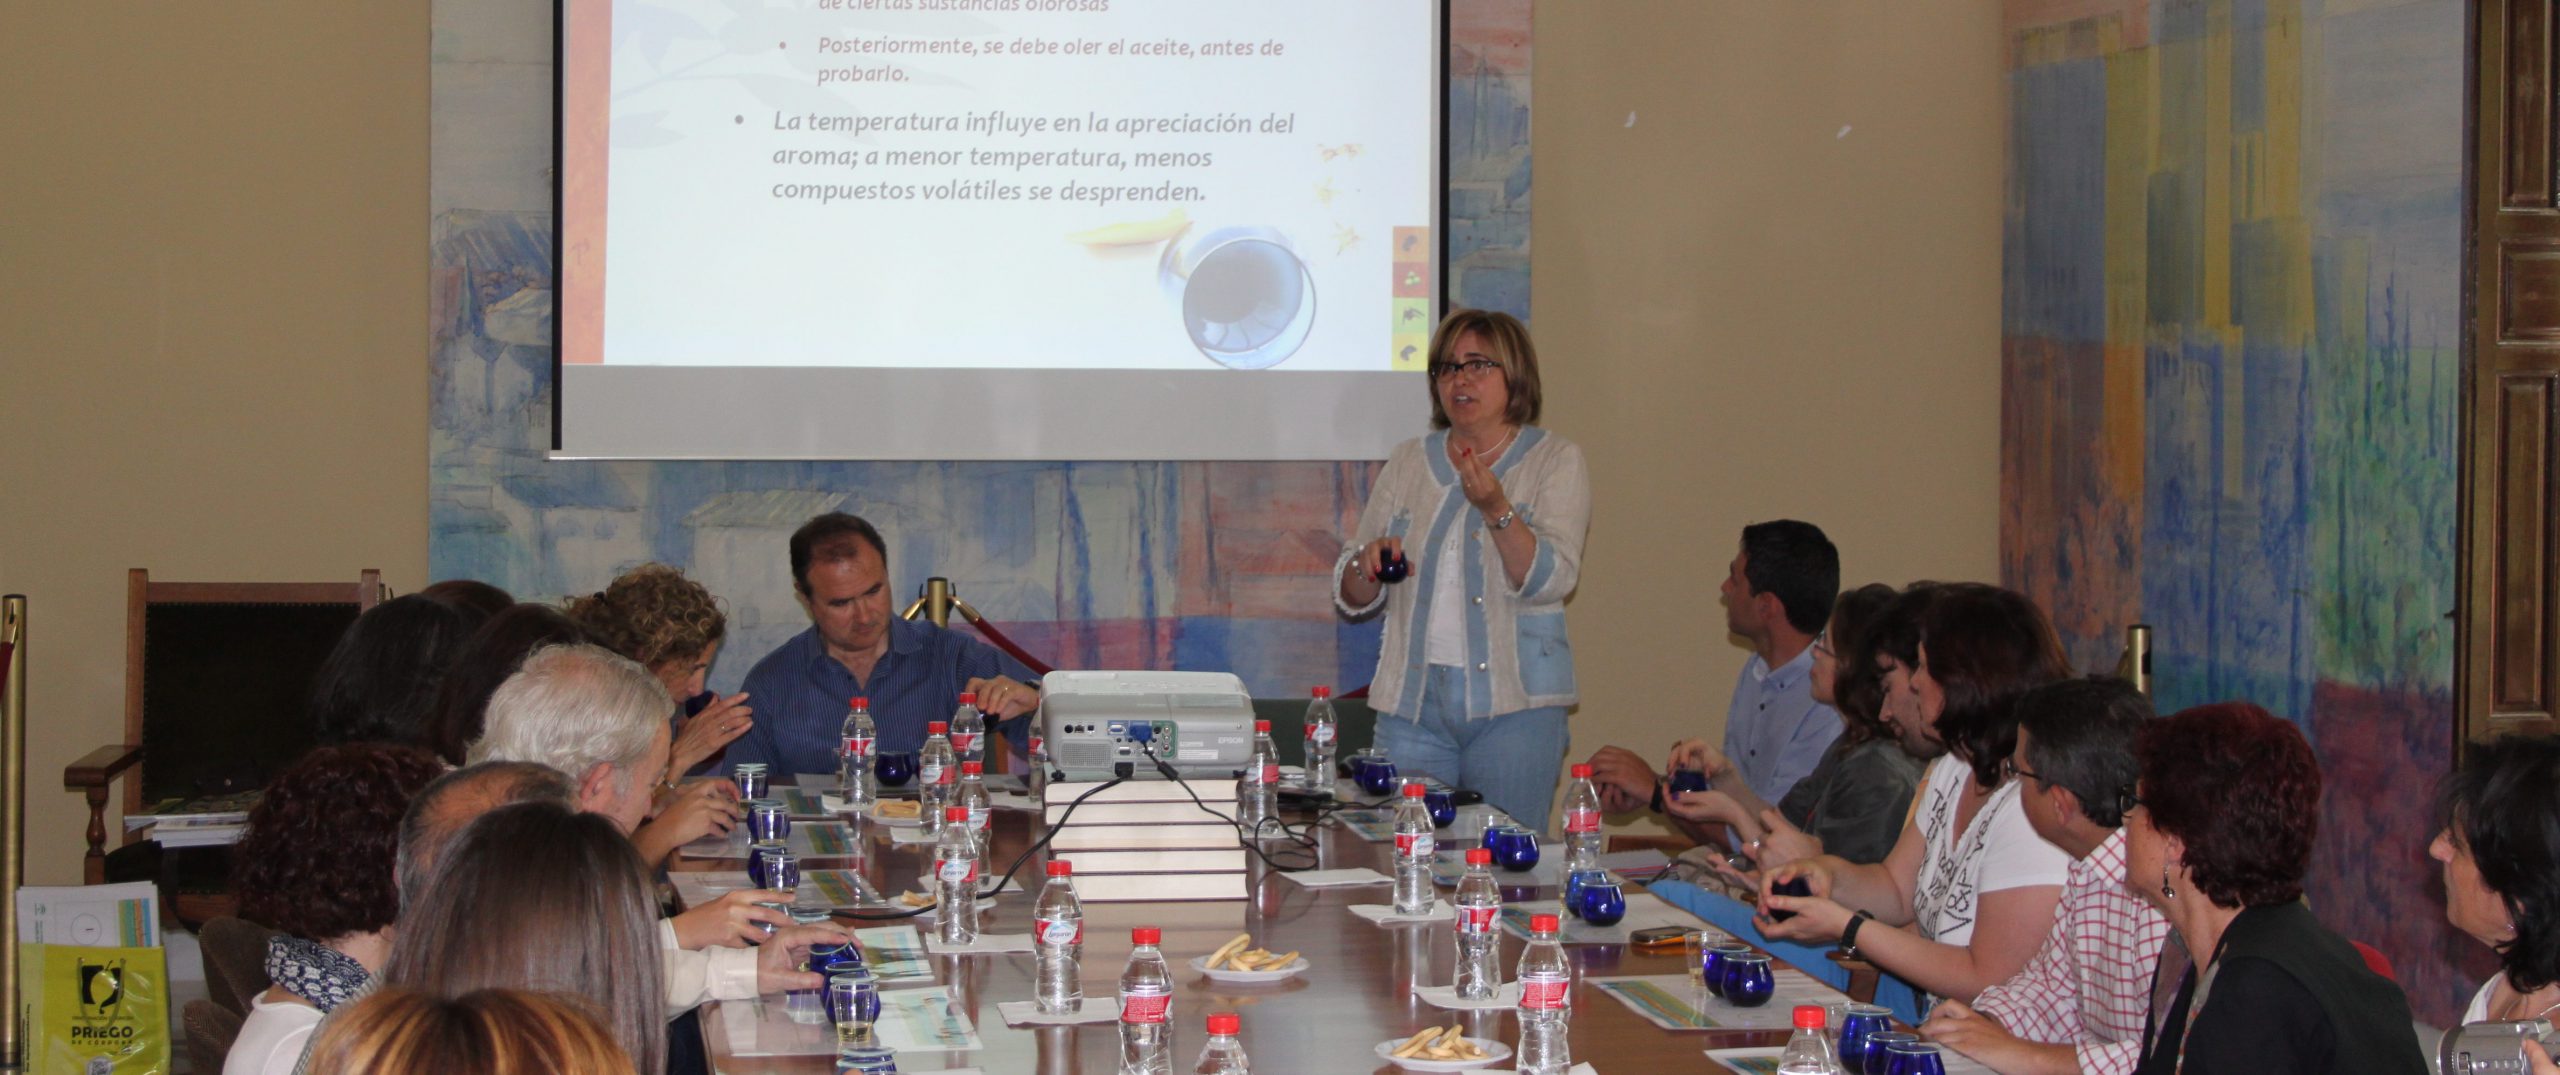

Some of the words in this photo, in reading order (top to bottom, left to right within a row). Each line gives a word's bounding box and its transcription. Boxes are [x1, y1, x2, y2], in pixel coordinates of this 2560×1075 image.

[818, 0, 843, 12] de
[847, 0, 913, 12] ciertas
[918, 0, 1020, 12] sustancias
[1024, 0, 1109, 12] olorosas
[818, 35, 978, 57] Posteriormente,
[983, 41, 1004, 54] se
[1009, 37, 1059, 55] debe
[1062, 38, 1103, 55] oler
[1108, 38, 1125, 55] el
[1129, 38, 1195, 59] aceite,
[1200, 40, 1254, 56] antes
[1260, 38, 1284, 56] de
[816, 63, 910, 87] probarlo.
[774, 110, 802, 131] La
[808, 112, 960, 137] temperatura
[965, 110, 1047, 138] influye
[1052, 117, 1081, 132] en
[1088, 111, 1109, 133] la
[1115, 112, 1252, 139] apreciación
[1259, 112, 1295, 134] del
[771, 149, 859, 170] aroma;
[864, 150, 879, 166] a
[885, 150, 964, 168] menor
[968, 146, 1127, 172] temperatura,
[1134, 152, 1213, 168] menos
[772, 181, 916, 205] compuestos
[922, 178, 1022, 200] volátiles
[1028, 185, 1053, 200] se
[1059, 179, 1206, 207] desprenden.
[1218, 736, 1244, 744] EPSON
[72, 1026, 133, 1038] PRIEGO
